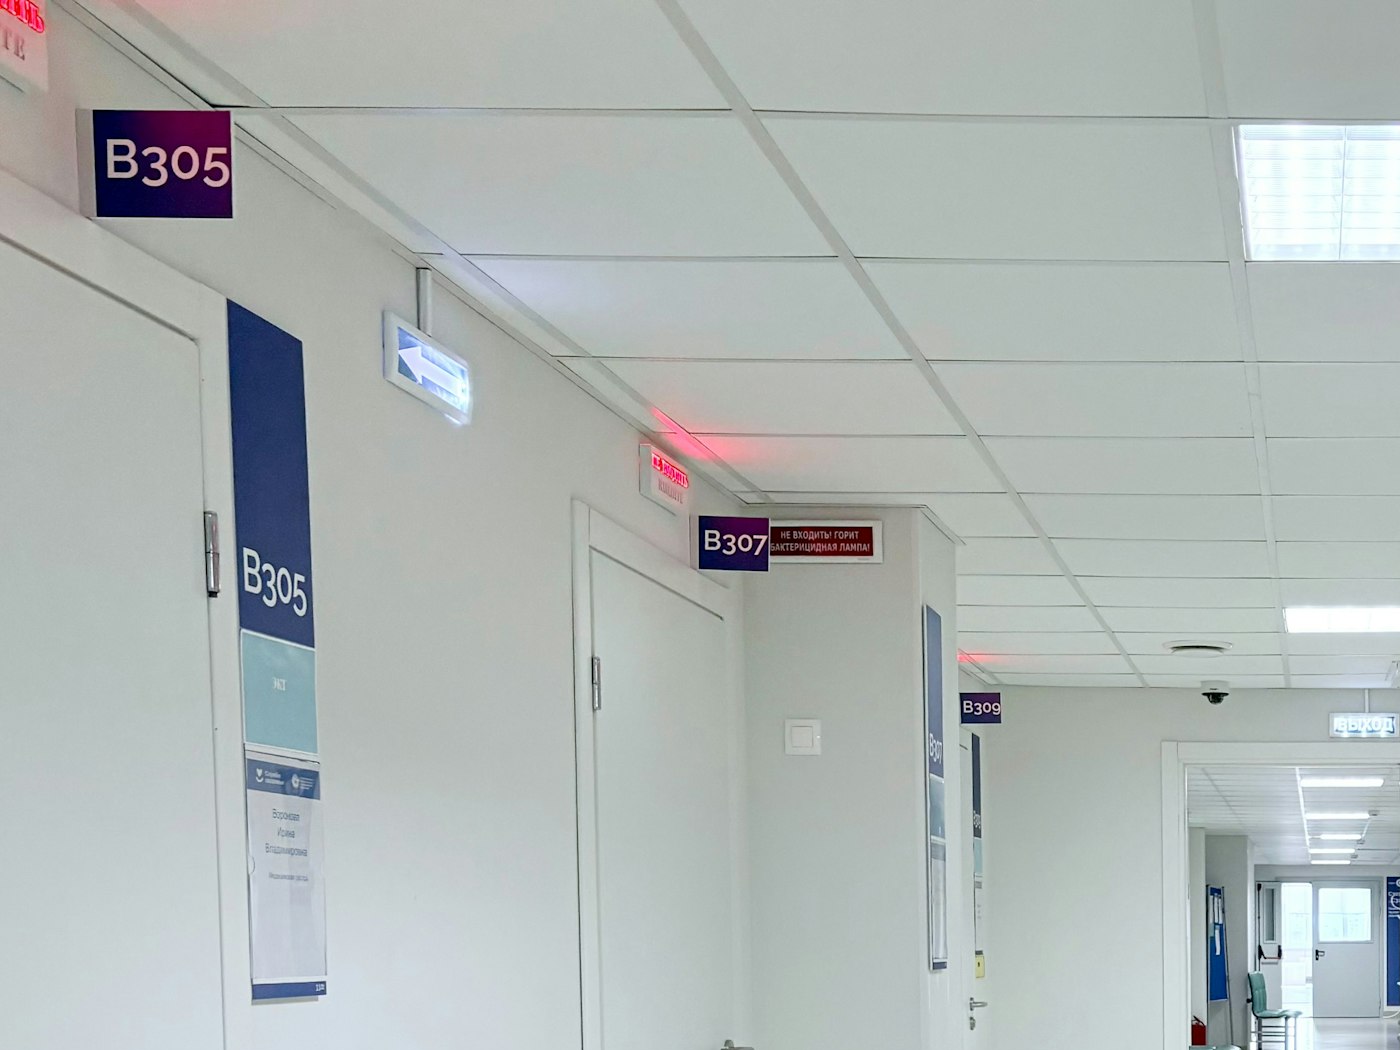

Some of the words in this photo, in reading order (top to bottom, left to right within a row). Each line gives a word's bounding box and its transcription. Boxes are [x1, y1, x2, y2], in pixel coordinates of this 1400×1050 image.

[106, 138, 230, 188] B305
[704, 529, 768, 556] B307
[770, 543, 838, 552] БАКТЕРИЦИДНАЯ
[839, 543, 870, 552] ЛАМПА!
[780, 531, 791, 539] НЕ
[793, 531, 832, 540] ВХОДИТЬ!
[834, 531, 859, 539] ГОРИТ
[243, 547, 307, 616] B305
[963, 700, 1001, 716] B309
[929, 733, 942, 764] B307
